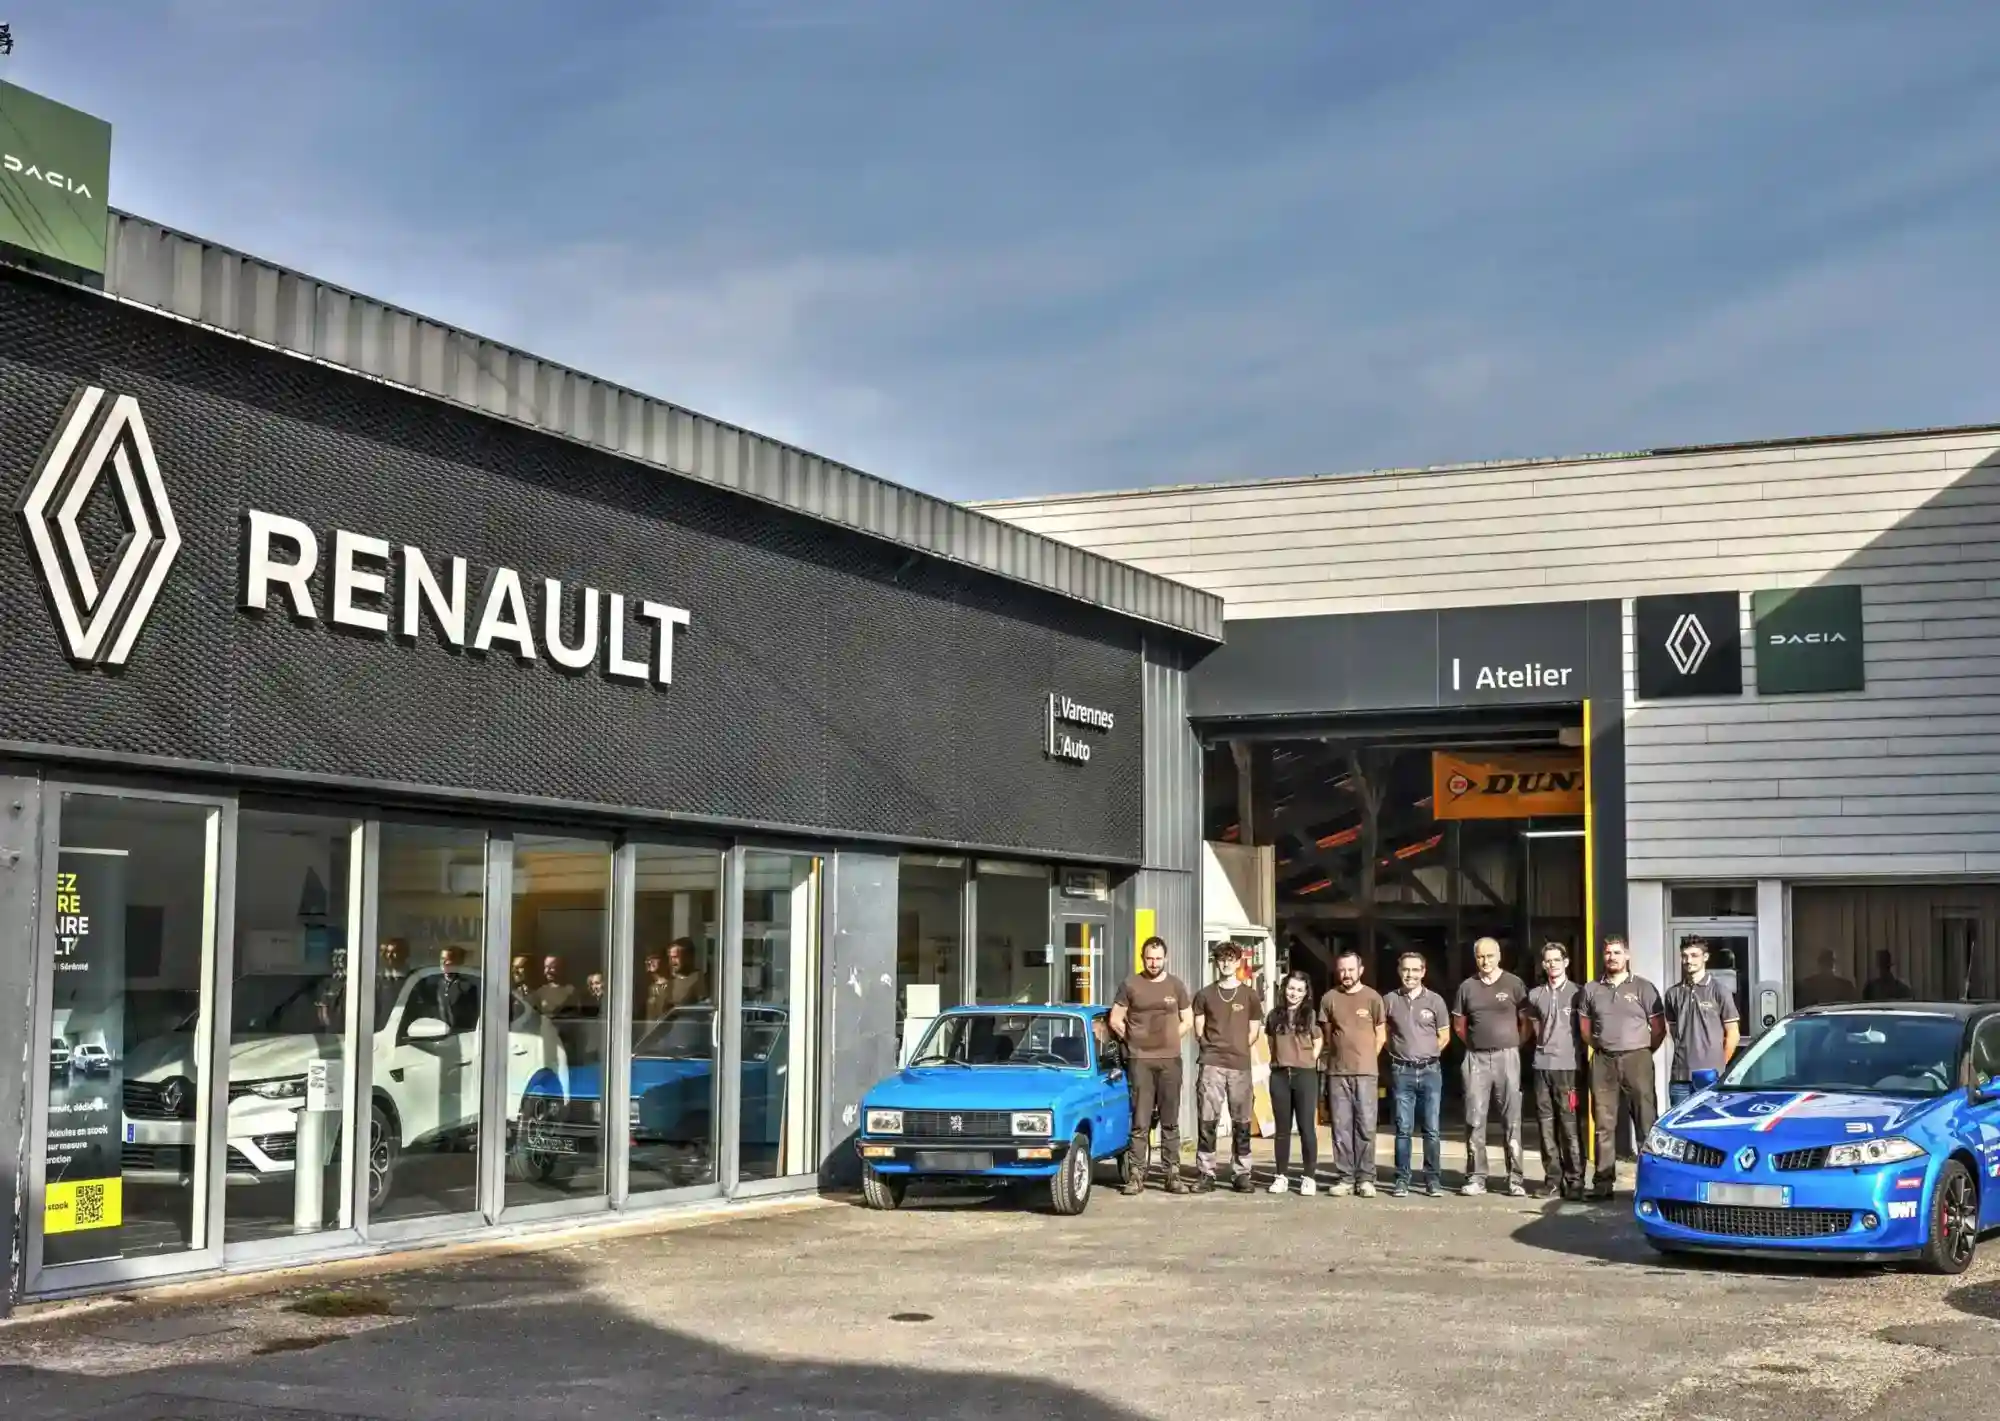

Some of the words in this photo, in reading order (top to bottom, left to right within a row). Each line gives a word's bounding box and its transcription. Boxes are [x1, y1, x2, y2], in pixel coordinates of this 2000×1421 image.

[3, 154, 92, 199] DACIA
[246, 508, 691, 685] RENAULT
[1770, 632, 1846, 645] DACIA
[1475, 663, 1573, 690] Atelier
[1061, 695, 1115, 729] Varennes
[1062, 736, 1091, 760] Auto
[1481, 771, 1584, 795] DUN
[57, 894, 81, 913] RE
[48, 1200, 69, 1211] stock
